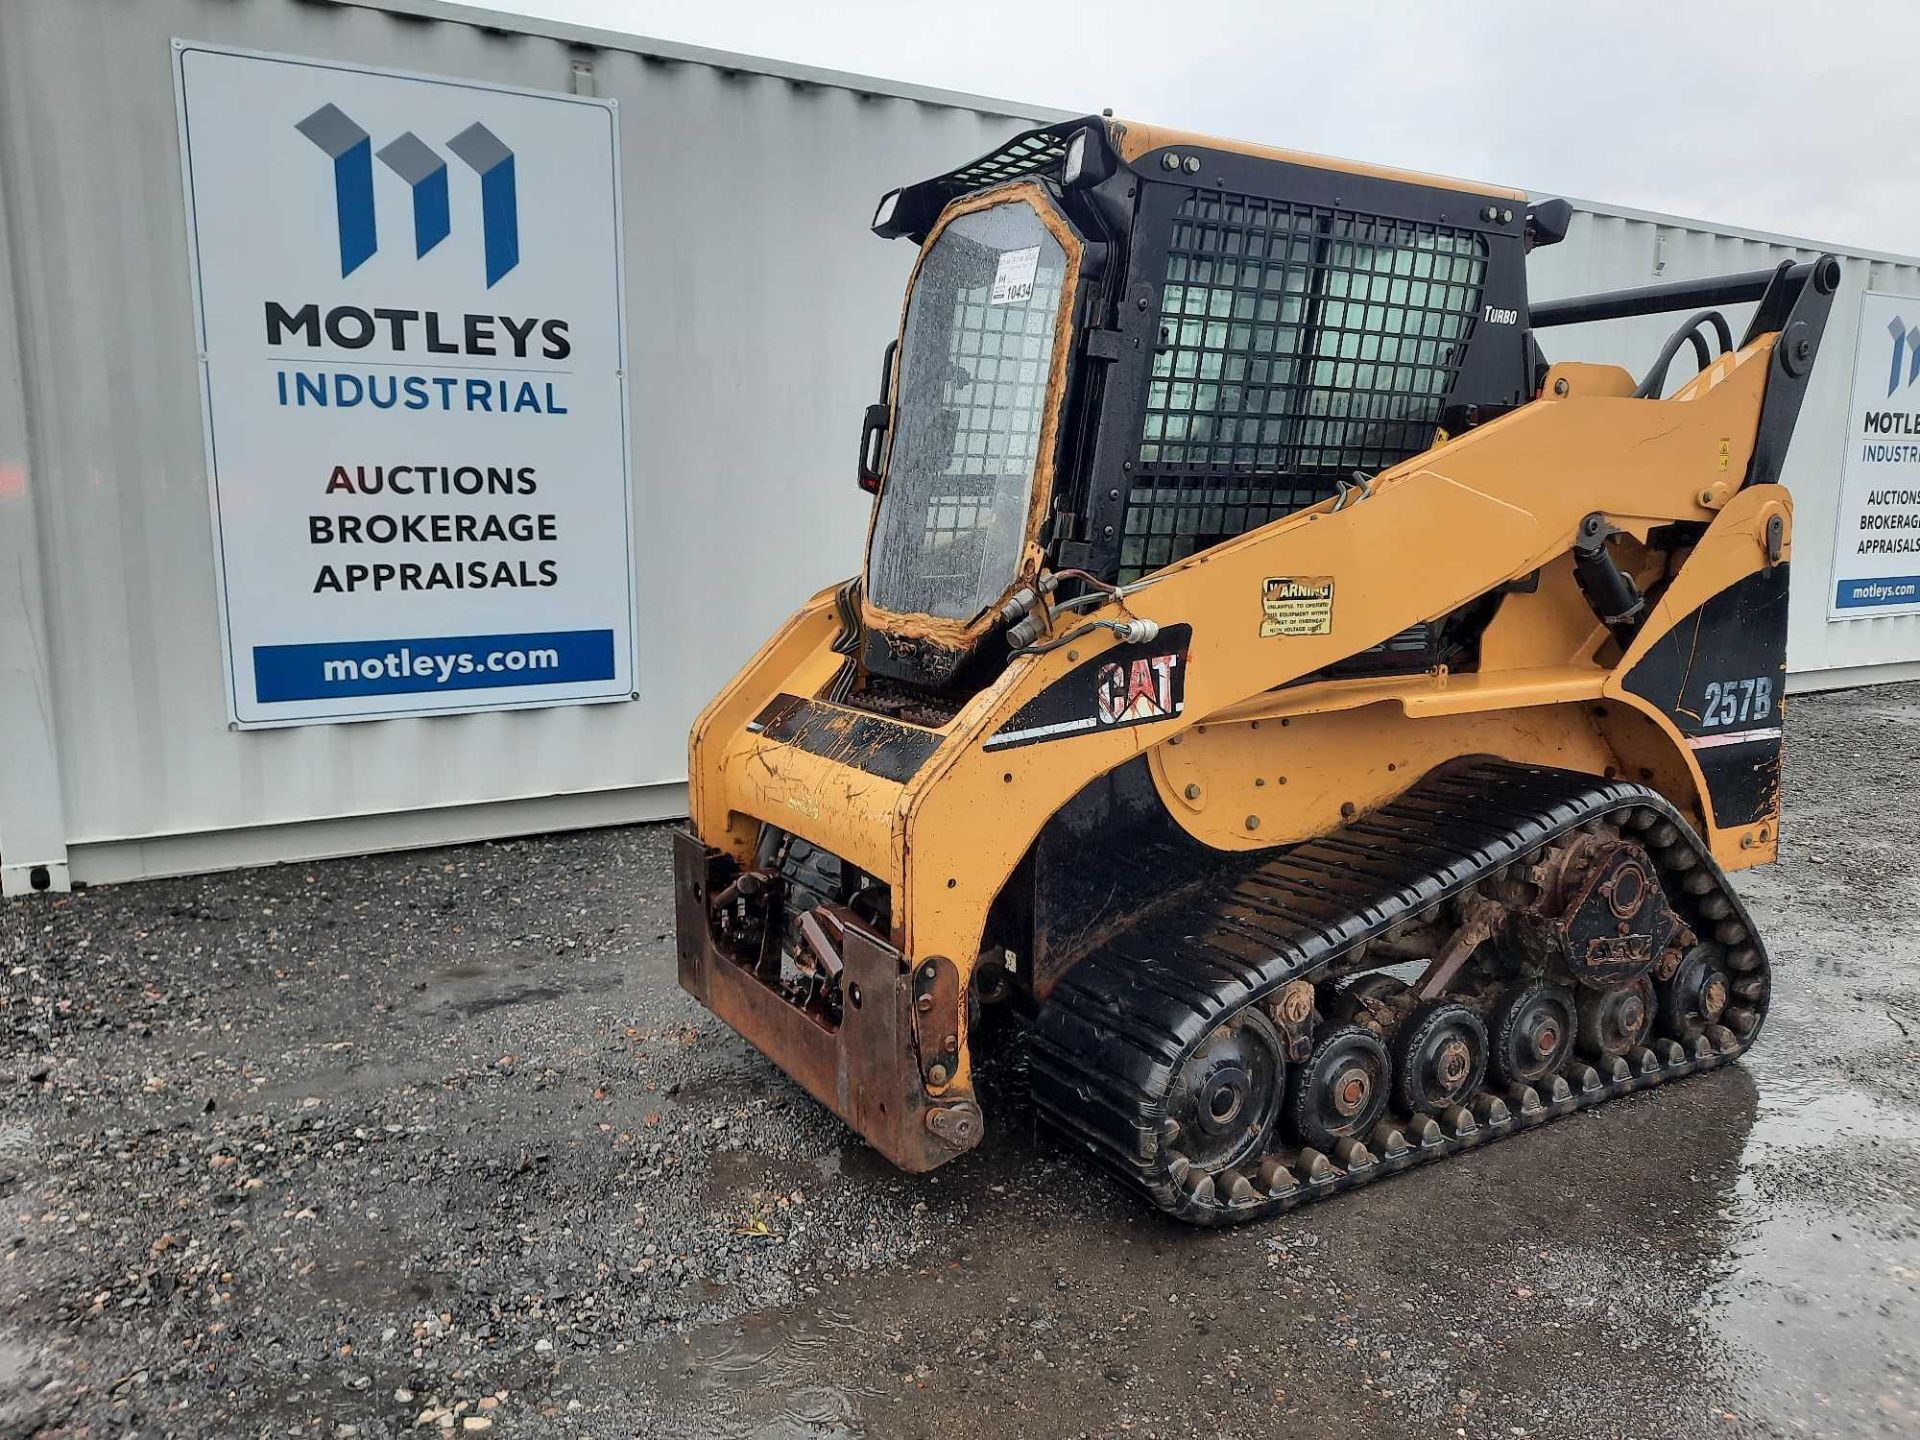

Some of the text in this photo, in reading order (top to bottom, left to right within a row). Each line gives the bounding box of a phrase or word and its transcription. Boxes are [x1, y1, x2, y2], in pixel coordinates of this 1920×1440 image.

[1007, 282, 1032, 300] 10434
[1484, 305, 1518, 325] TURBO
[265, 301, 571, 360] MOTLEYS
[278, 371, 568, 414] INDUSTRIAL
[1862, 444, 1920, 463] INDUSTR
[326, 465, 537, 495] AUCTIONS
[309, 514, 558, 544] BROKERAGE
[1860, 514, 1920, 530] BROKERAG
[1857, 538, 1920, 554] APPRAISALS
[313, 560, 558, 593] APPRAISALS
[1853, 583, 1915, 600] motleys.com
[323, 648, 559, 683] motleys.com
[1097, 654, 1178, 724] CAT
[1702, 676, 1773, 728] 257B
